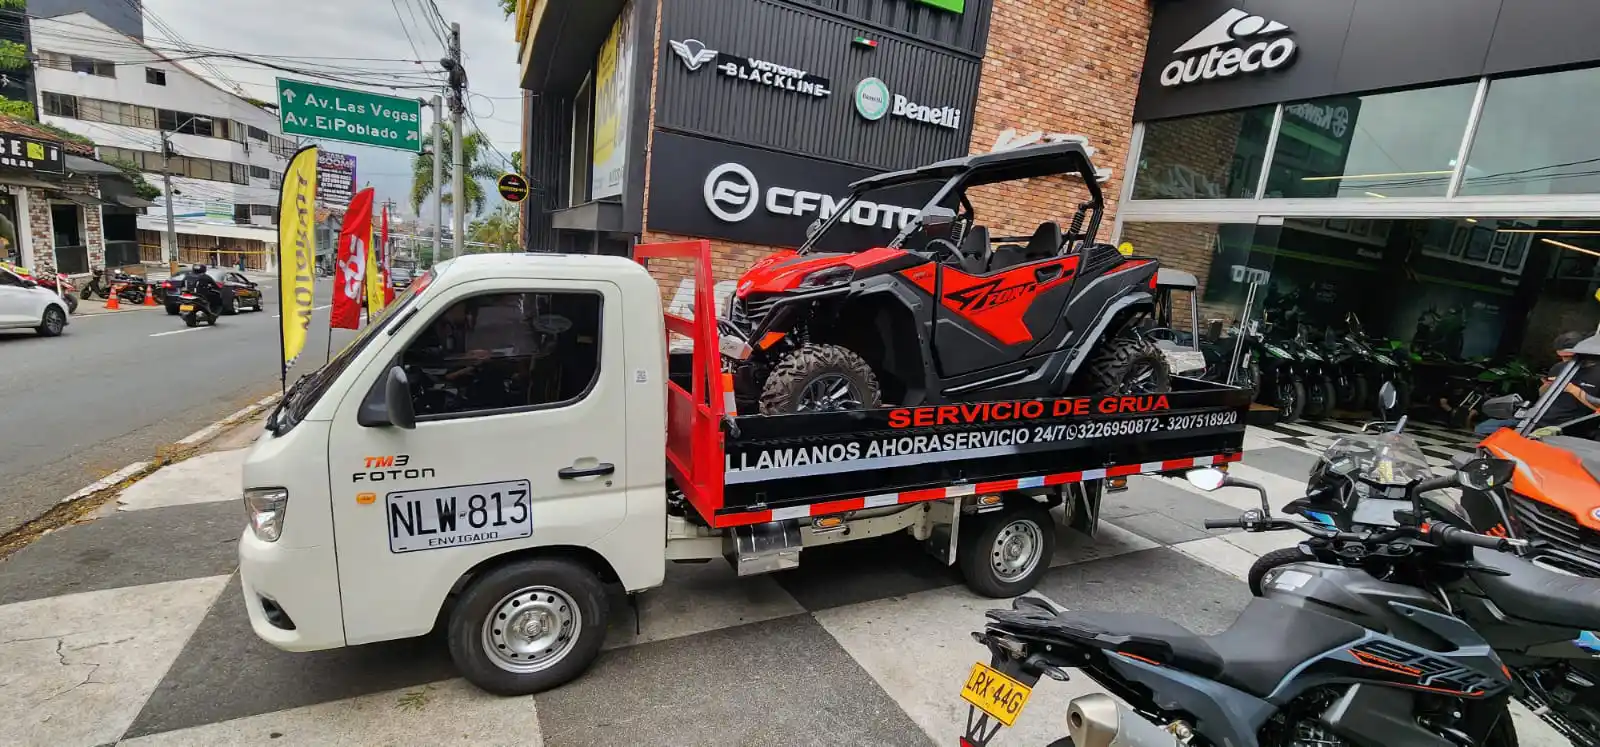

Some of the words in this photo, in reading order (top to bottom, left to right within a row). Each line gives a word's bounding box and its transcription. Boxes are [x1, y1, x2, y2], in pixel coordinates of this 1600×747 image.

[717, 61, 831, 96] BLACKLINE
[748, 58, 806, 77] VICTORY
[1160, 38, 1294, 86] auteco
[370, 103, 417, 123] Vegas
[892, 93, 960, 129] Benelli
[765, 186, 924, 229] CFMOTO
[888, 399, 1044, 428] SERVICIO
[1053, 398, 1090, 417] DE
[1099, 395, 1170, 414] GRUA
[725, 442, 860, 472] LLAMANOS
[1033, 425, 1066, 442] 24/7
[1167, 411, 1237, 431] 3207518920
[364, 455, 410, 468] TM3
[429, 531, 498, 547] ENVIGADO
[967, 669, 994, 698] LRX
[993, 683, 1023, 714] 44G
